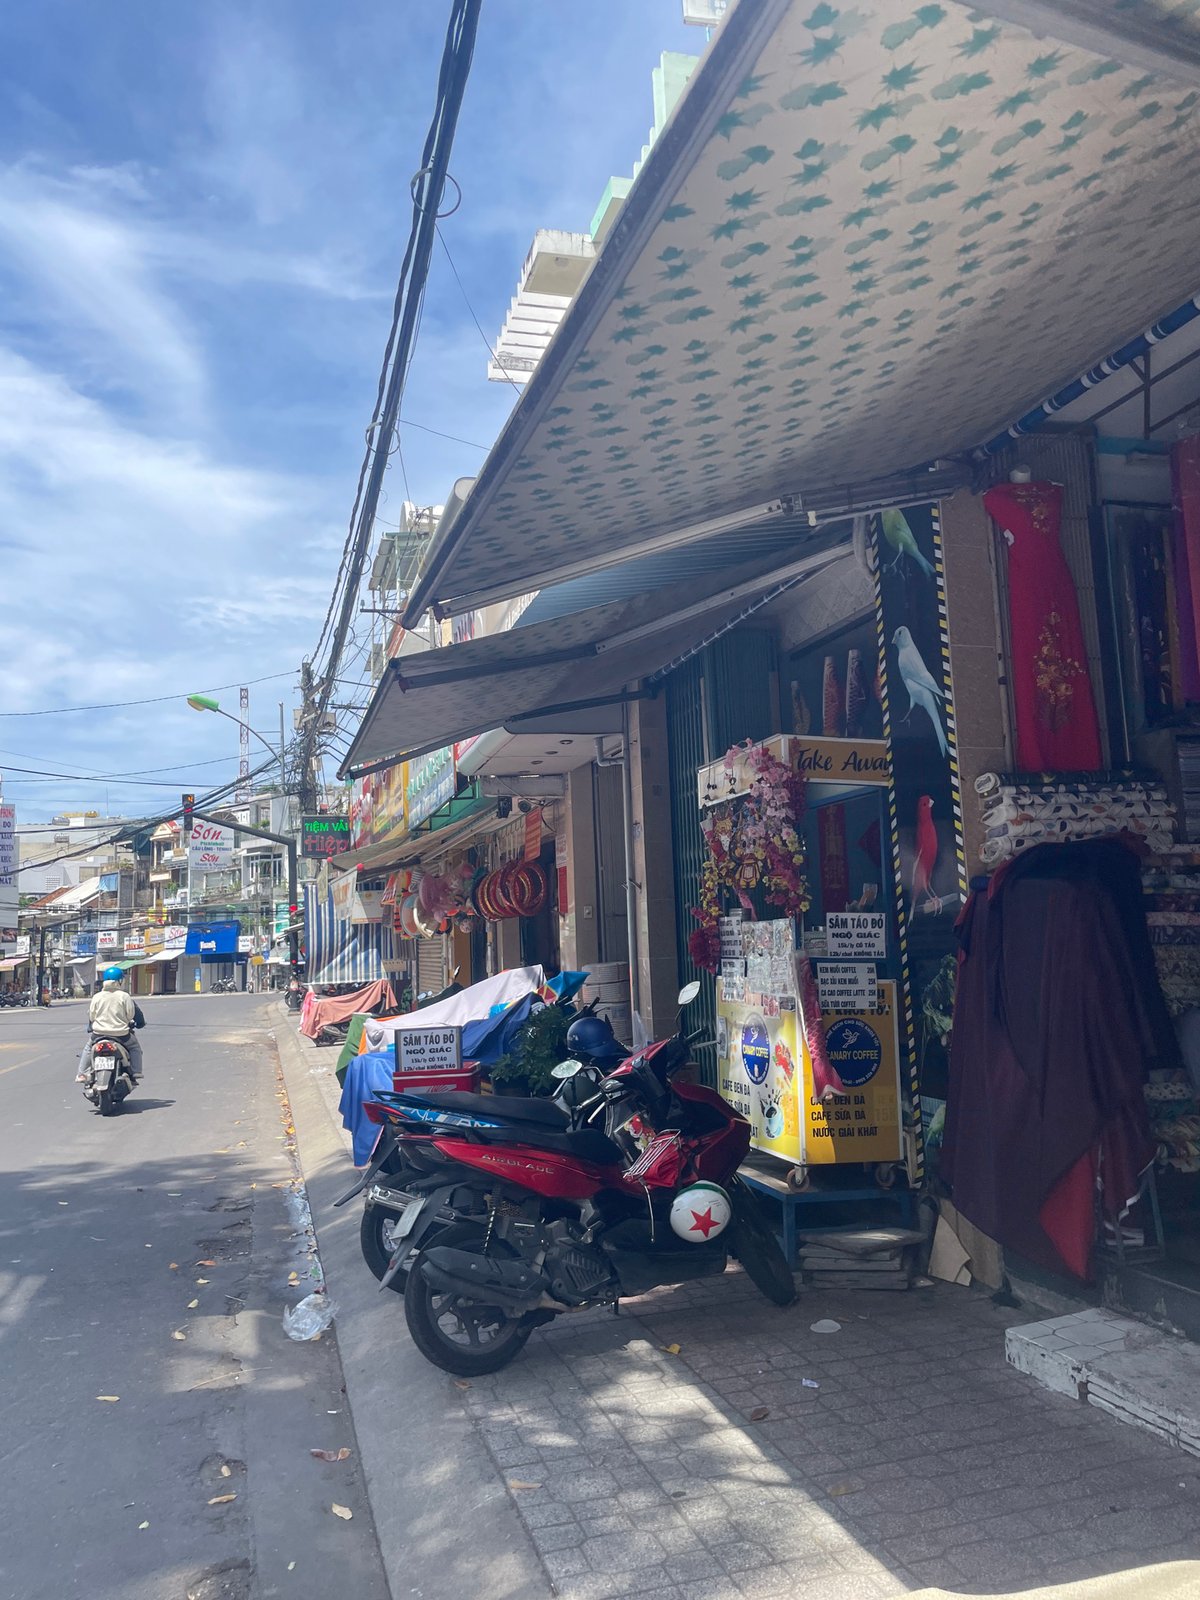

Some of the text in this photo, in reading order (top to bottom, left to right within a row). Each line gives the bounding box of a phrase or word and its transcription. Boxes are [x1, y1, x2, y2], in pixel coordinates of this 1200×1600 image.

[796, 748, 892, 778] Take Away
[828, 914, 884, 929] SÂM TÁO ĐỎ
[856, 930, 880, 939] GIÁC
[841, 966, 857, 974] COFFEE
[836, 989, 852, 997] COFFEE
[852, 989, 866, 997] LATTE
[841, 1000, 856, 1008] COFFEE
[402, 1029, 455, 1047] SÂM TÁO ĐỎ
[755, 1046, 769, 1059] COFFEE
[828, 1049, 879, 1060] ANARY COFFEE
[833, 1095, 851, 1105] ĐEN
[854, 1092, 866, 1105] ĐÁ
[811, 1110, 832, 1121] CAFE
[834, 1107, 852, 1121] SỮA
[854, 1107, 867, 1120] ĐÁ
[812, 1123, 879, 1138] NƯỚC GIẢI KHÁT
